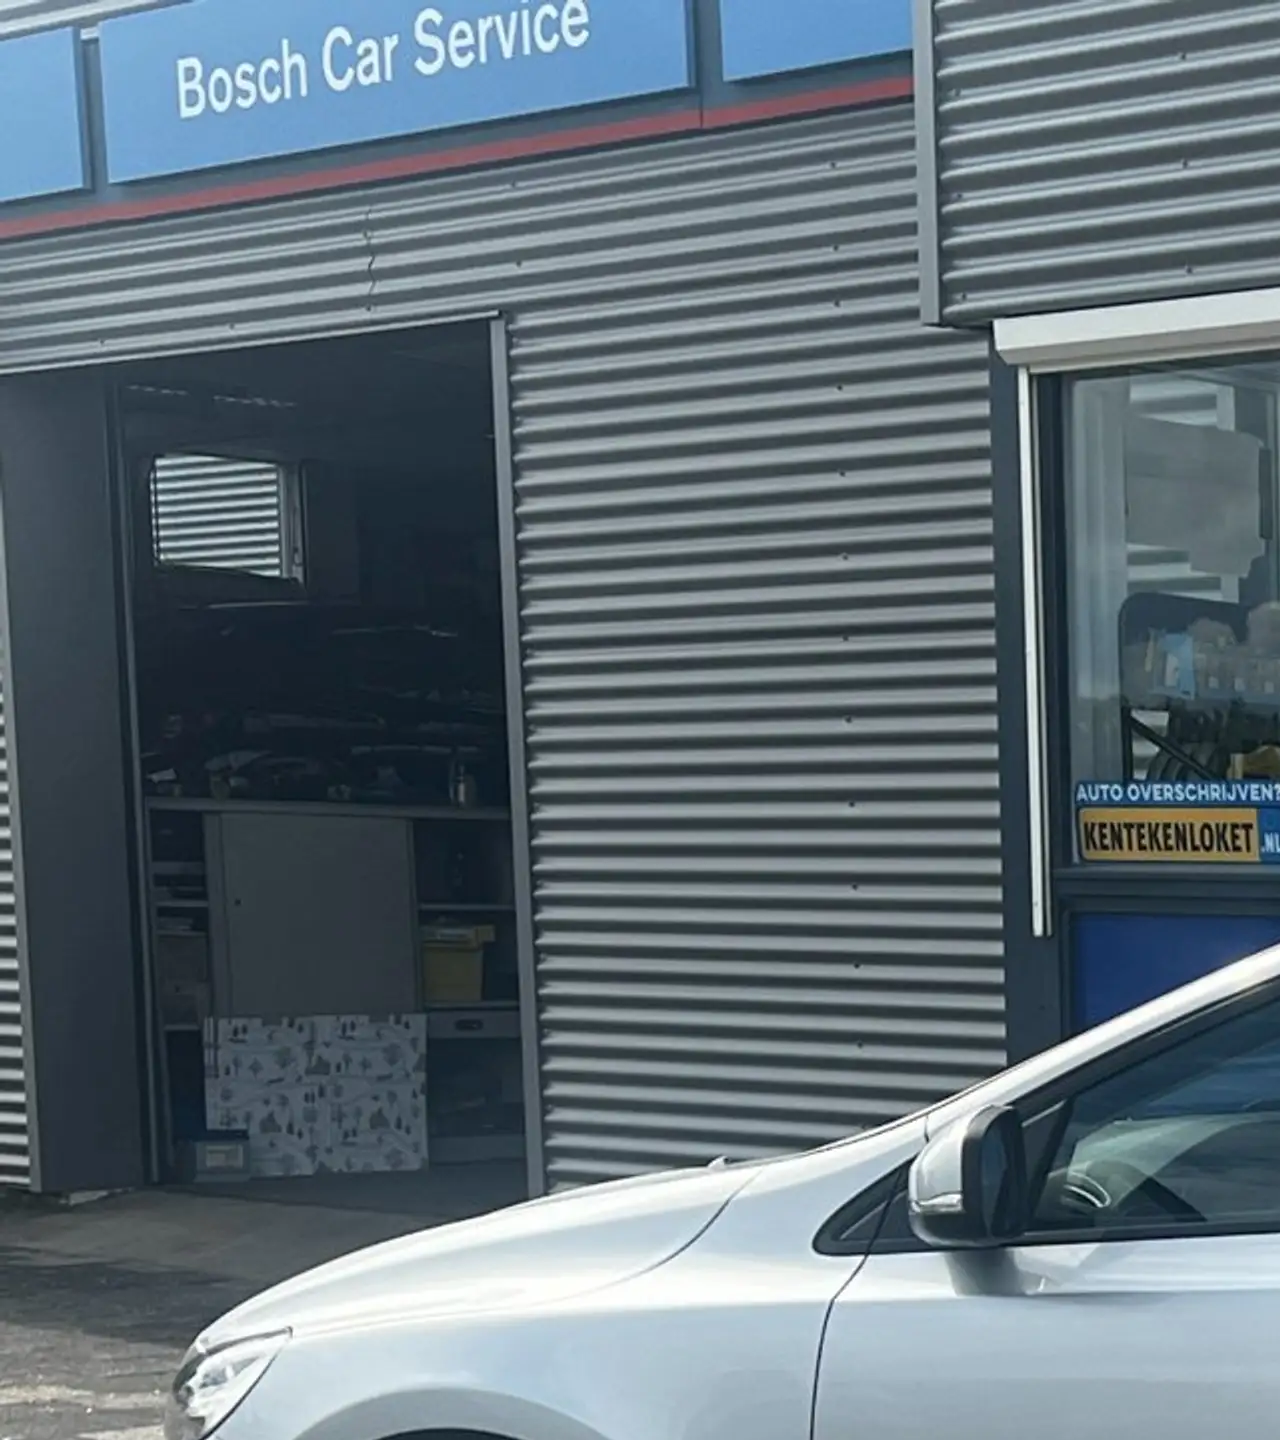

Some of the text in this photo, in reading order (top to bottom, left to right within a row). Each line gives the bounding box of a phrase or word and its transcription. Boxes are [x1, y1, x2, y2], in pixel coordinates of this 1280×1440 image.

[177, 0, 591, 119] Bosch Car Service
[1076, 783, 1124, 801] AUTO
[1083, 822, 1254, 853] KENTEKENLOKET
